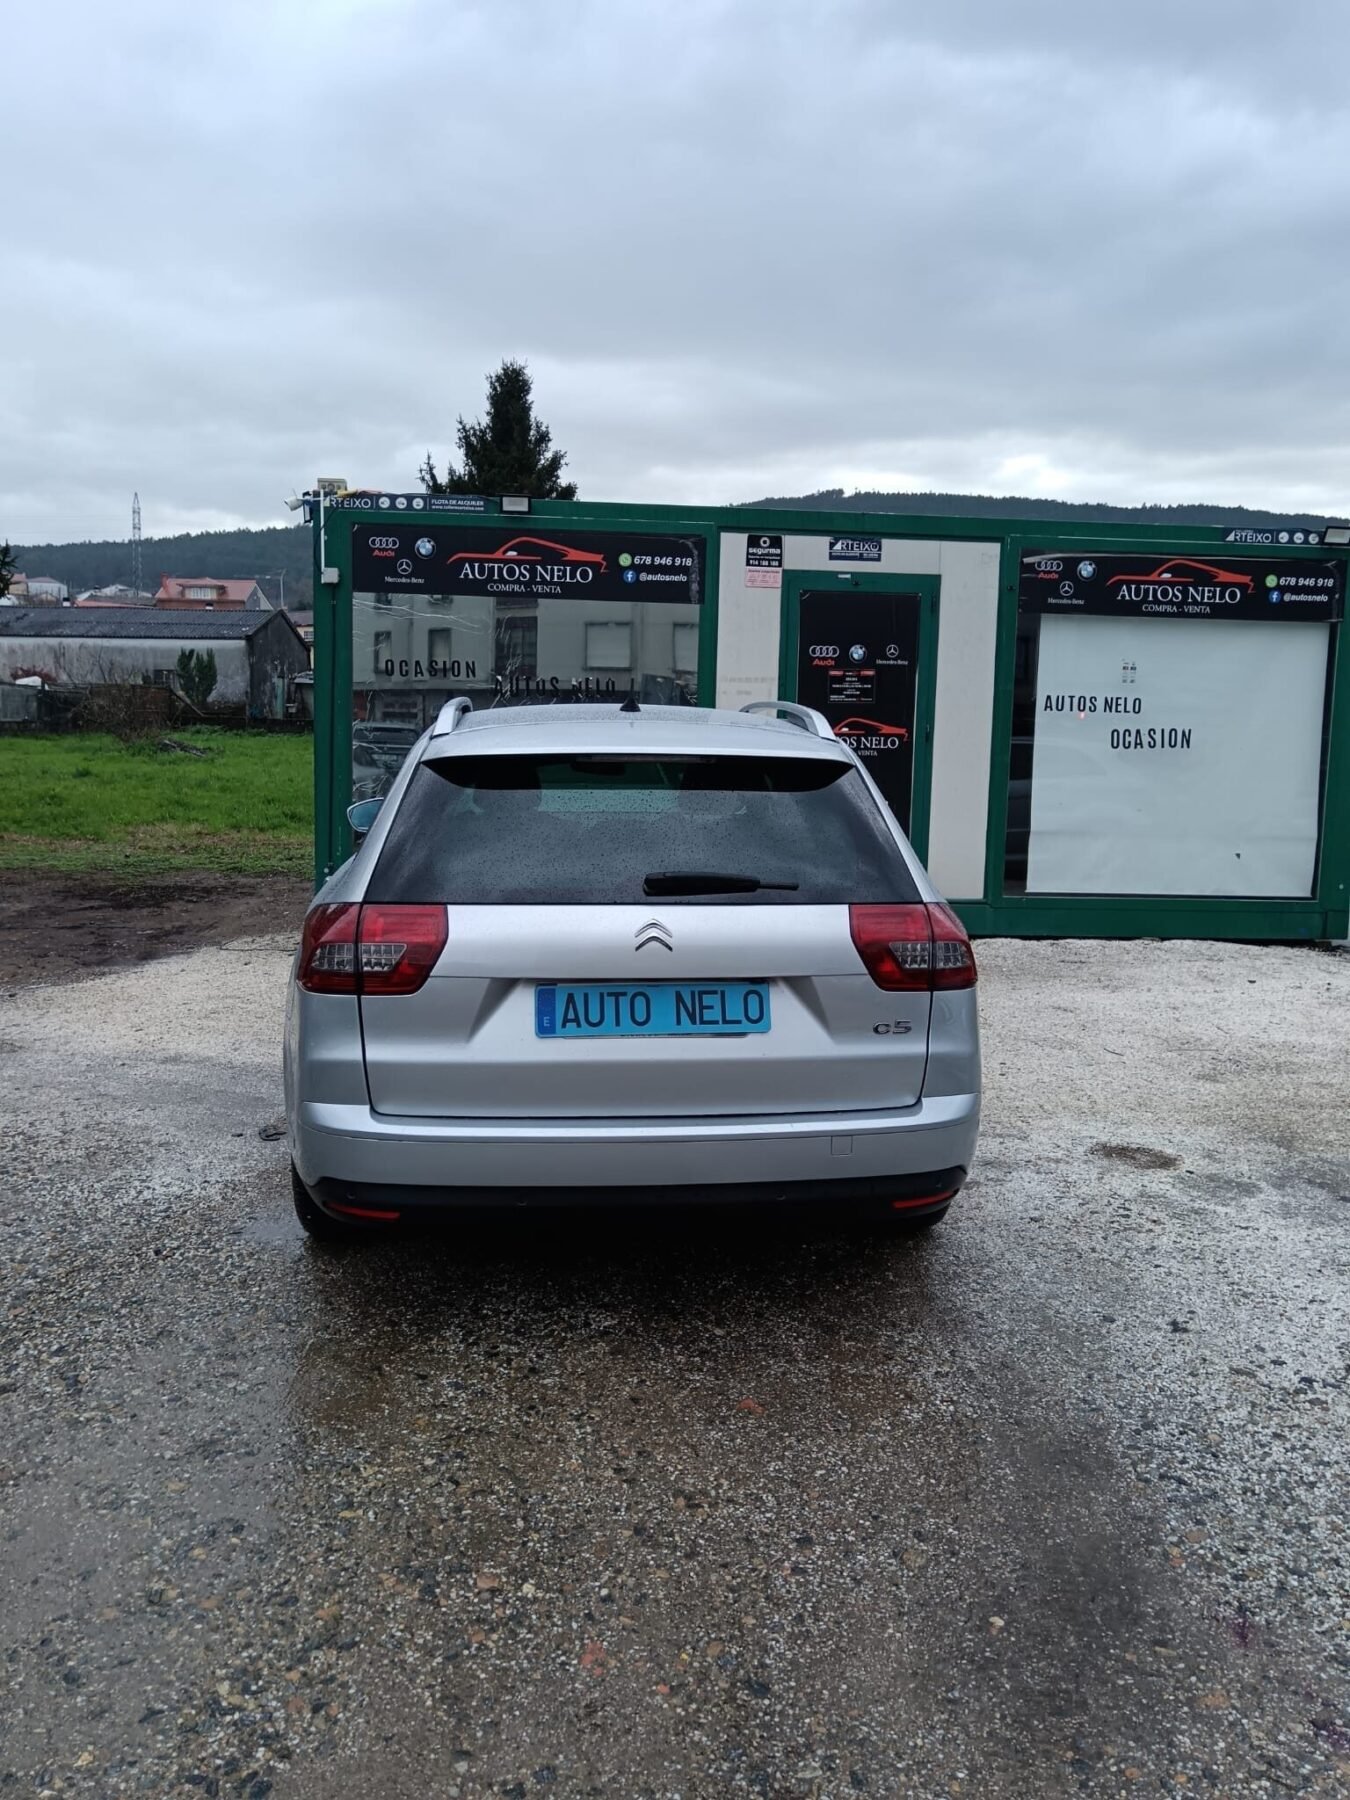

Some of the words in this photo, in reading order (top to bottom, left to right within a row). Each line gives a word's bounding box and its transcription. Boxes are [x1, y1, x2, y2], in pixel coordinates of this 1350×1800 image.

[373, 549, 395, 557] Audi
[633, 555, 652, 565] 678
[653, 556, 673, 566] 946
[674, 557, 693, 566] 918
[459, 562, 530, 581] AUTOS
[535, 565, 593, 583] NELO
[639, 572, 687, 582] @autosnelo
[1279, 576, 1296, 586] 678
[1297, 577, 1315, 587] 946
[1316, 578, 1334, 587] 918
[487, 583, 526, 593] COMPRA
[532, 584, 562, 594] VENTA
[1116, 584, 1182, 602] AUTOS
[1188, 586, 1241, 604] NELO
[1283, 592, 1329, 602] @autosnelo
[1142, 603, 1178, 613] COMPRA
[1184, 605, 1211, 614] VENTA
[813, 658, 836, 666] Audi
[384, 659, 477, 679] OCASION
[1043, 695, 1098, 713] AUTOS
[1103, 696, 1142, 714] NELO
[861, 737, 899, 749] NELO
[1110, 728, 1192, 749] OCASION
[561, 990, 652, 1029] AUTO
[675, 989, 765, 1026] NELO
[543, 1015, 551, 1027] E
[872, 1020, 913, 1034] C5
